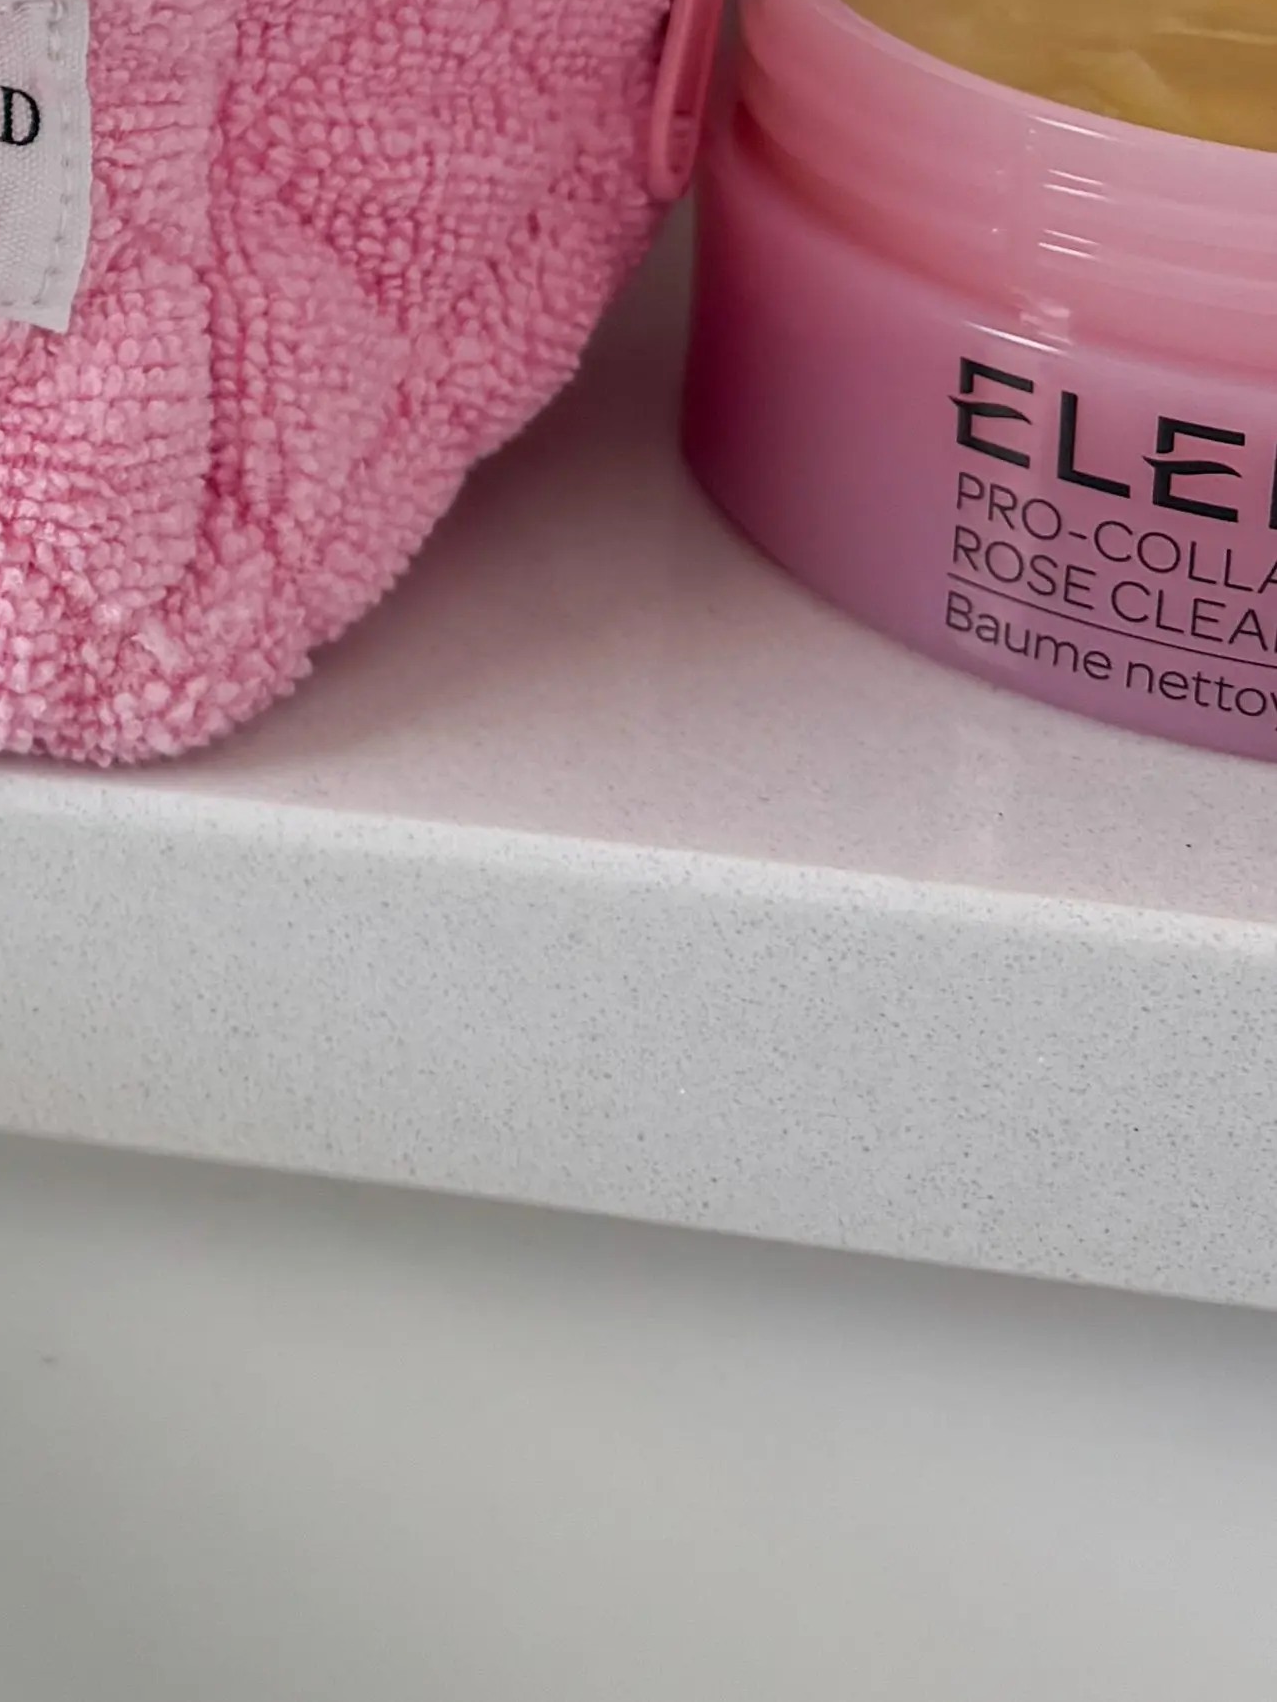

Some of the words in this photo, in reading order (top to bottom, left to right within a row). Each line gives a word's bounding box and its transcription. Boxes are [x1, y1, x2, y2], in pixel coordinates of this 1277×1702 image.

[947, 356, 1277, 531] ELE
[945, 588, 1113, 681] Baume
[952, 524, 1097, 612] ROSE
[1110, 580, 1277, 655] CLEA
